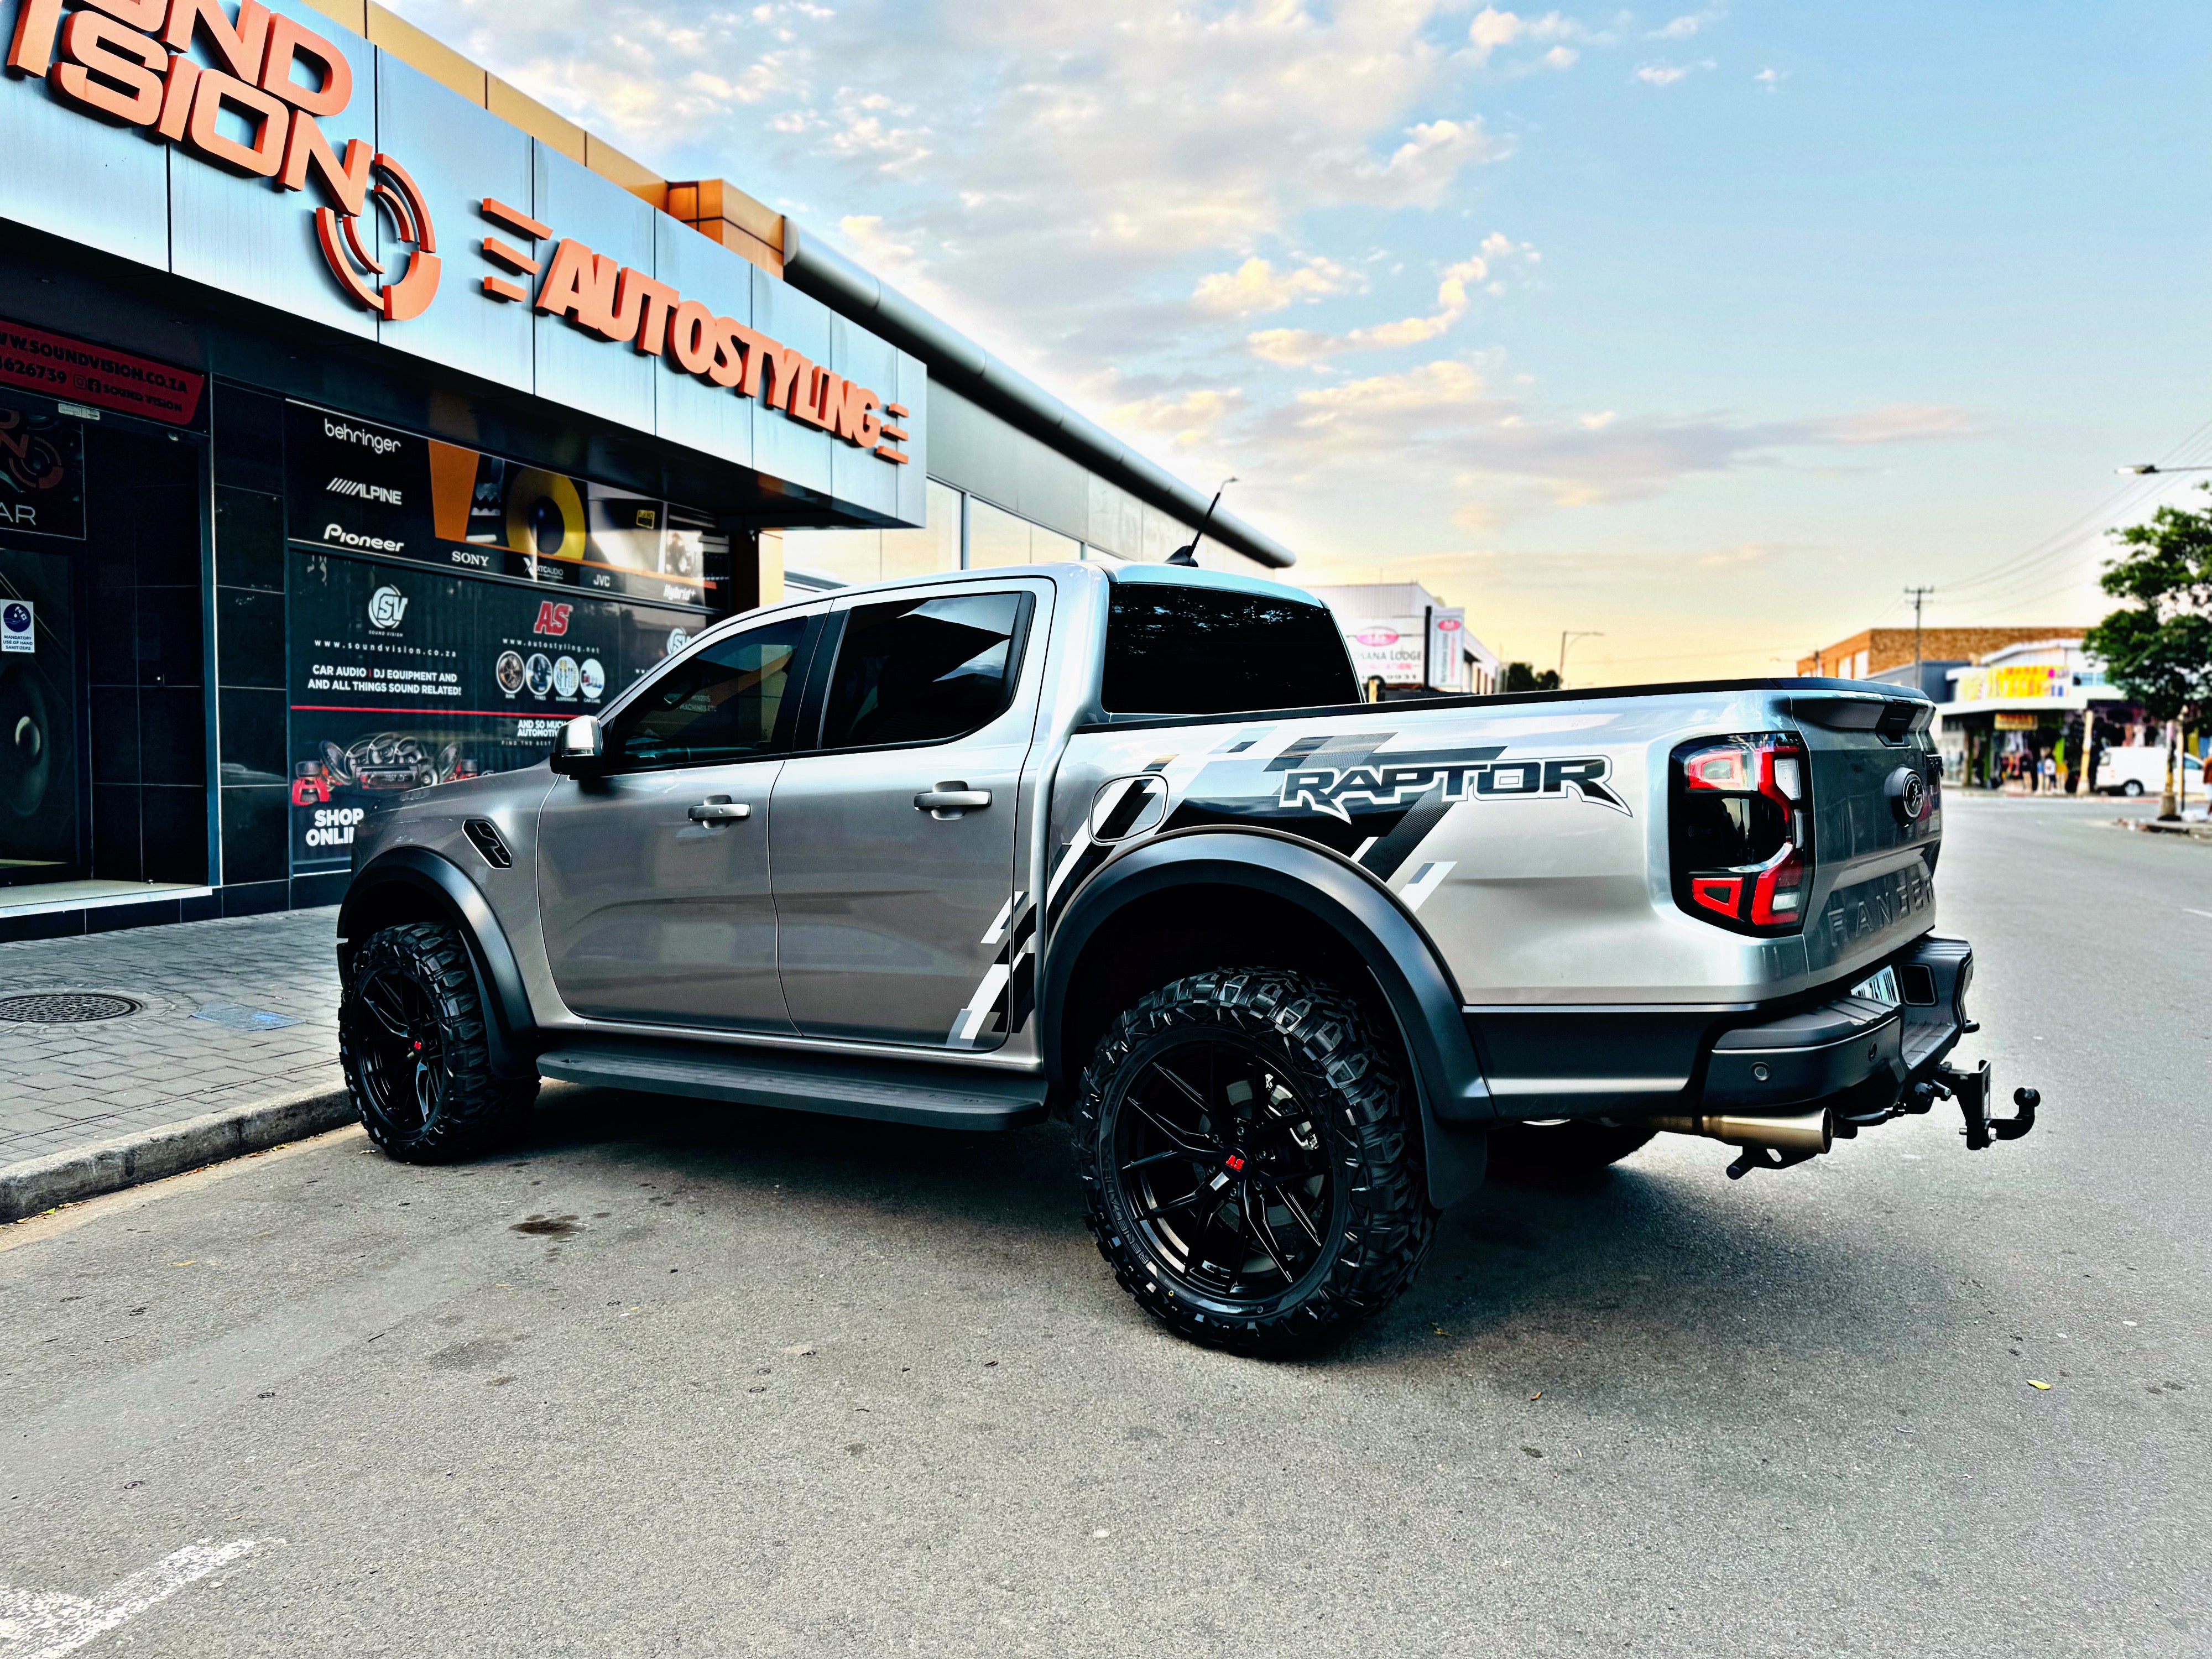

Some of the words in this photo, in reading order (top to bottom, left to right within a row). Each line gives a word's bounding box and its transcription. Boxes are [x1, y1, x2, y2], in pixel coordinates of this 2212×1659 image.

[536, 238, 881, 448] AUTOSTYLING
[103, 384, 144, 402] SOUND
[145, 394, 182, 413] VISION
[324, 418, 401, 454] behringer
[336, 479, 402, 505] ALPINE
[324, 524, 404, 552] Pioneer
[452, 551, 489, 566] SONY
[593, 573, 611, 587] JVC
[534, 601, 571, 635] AS
[312, 665, 333, 675] CAR
[336, 666, 367, 677] AUDIO
[374, 669, 385, 679] DJ
[387, 669, 437, 681] EQUIPMENT
[439, 672, 457, 682] AND
[307, 679, 330, 690] AND
[332, 680, 351, 691] ALL
[353, 681, 387, 692] THINGS
[389, 682, 420, 693] SOUND
[421, 685, 461, 696] RELATED!
[518, 719, 534, 728] AND
[535, 720, 546, 729] SO
[1279, 754, 1633, 825] RAPTOR
[315, 808, 364, 827] SHOP
[1225, 1155, 1244, 1170] AS
